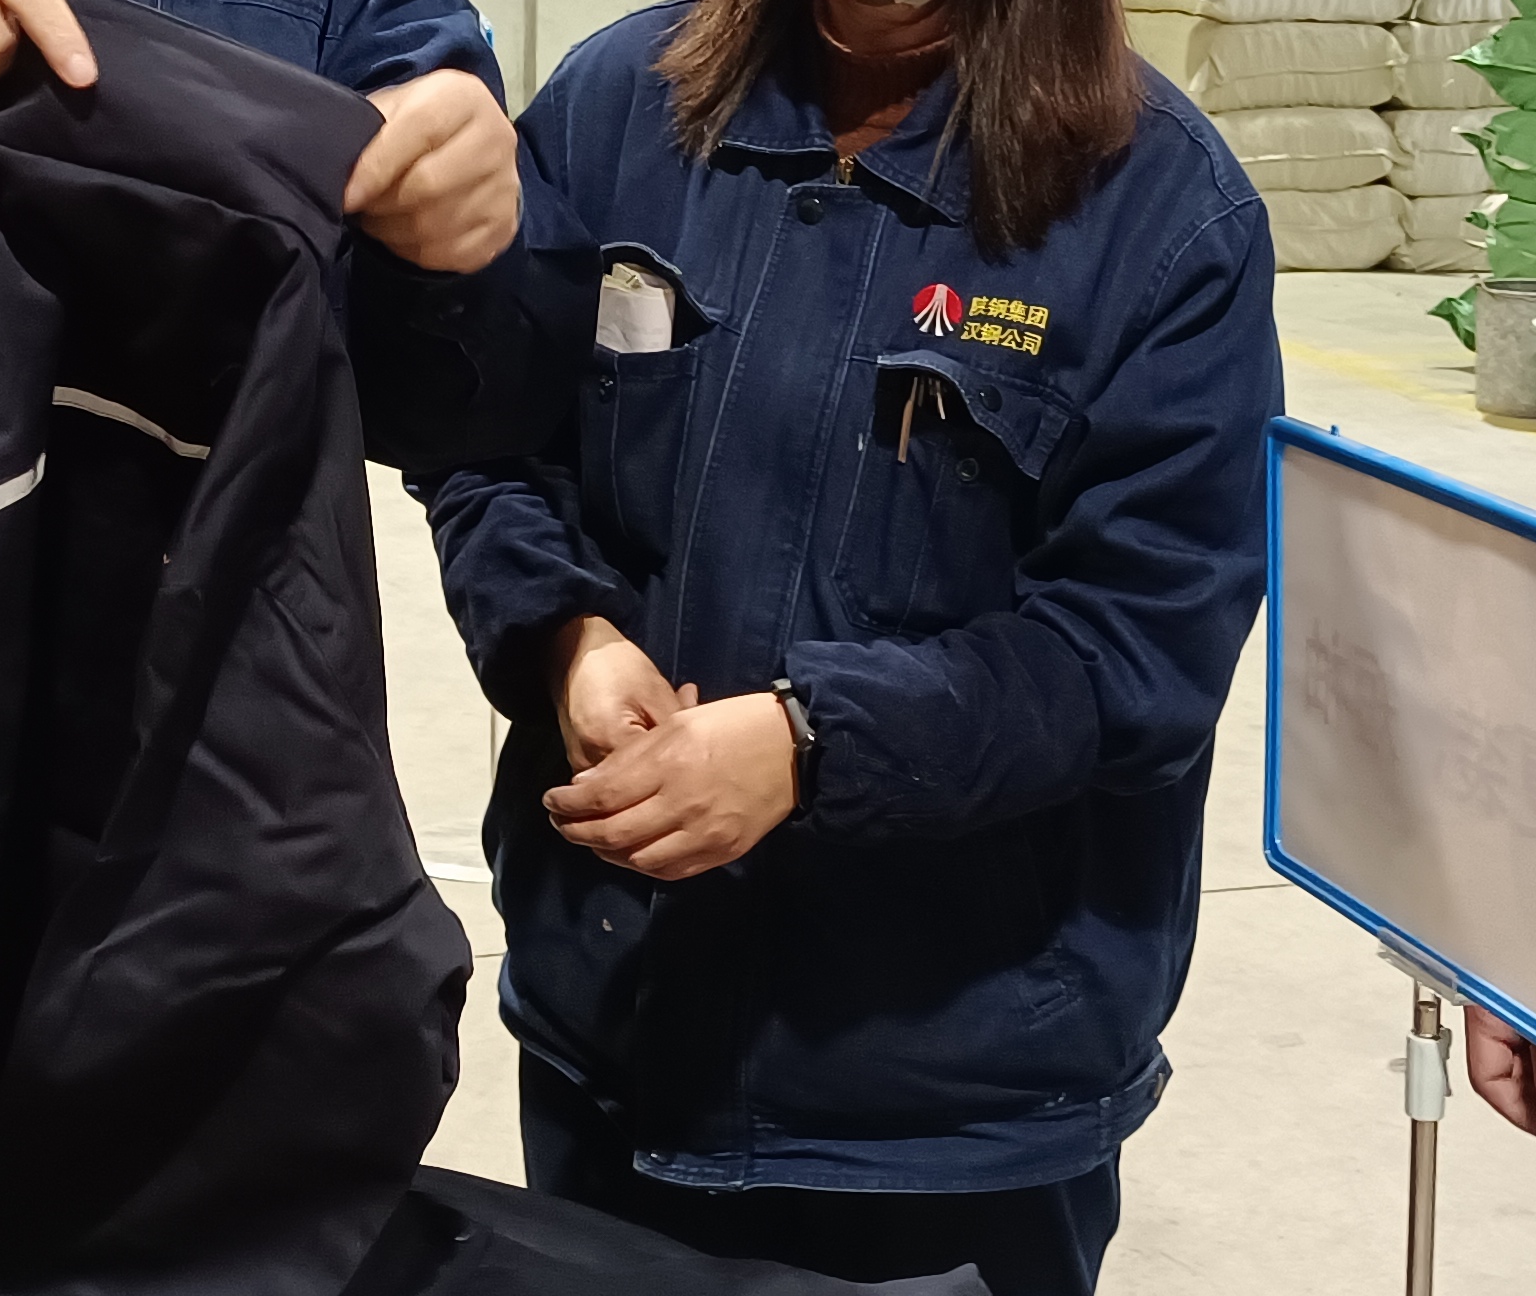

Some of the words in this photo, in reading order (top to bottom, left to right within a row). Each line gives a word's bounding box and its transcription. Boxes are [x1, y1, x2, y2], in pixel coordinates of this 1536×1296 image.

[969, 295, 1049, 330] 陕钢集团
[960, 320, 1043, 356] 汉钢公司
